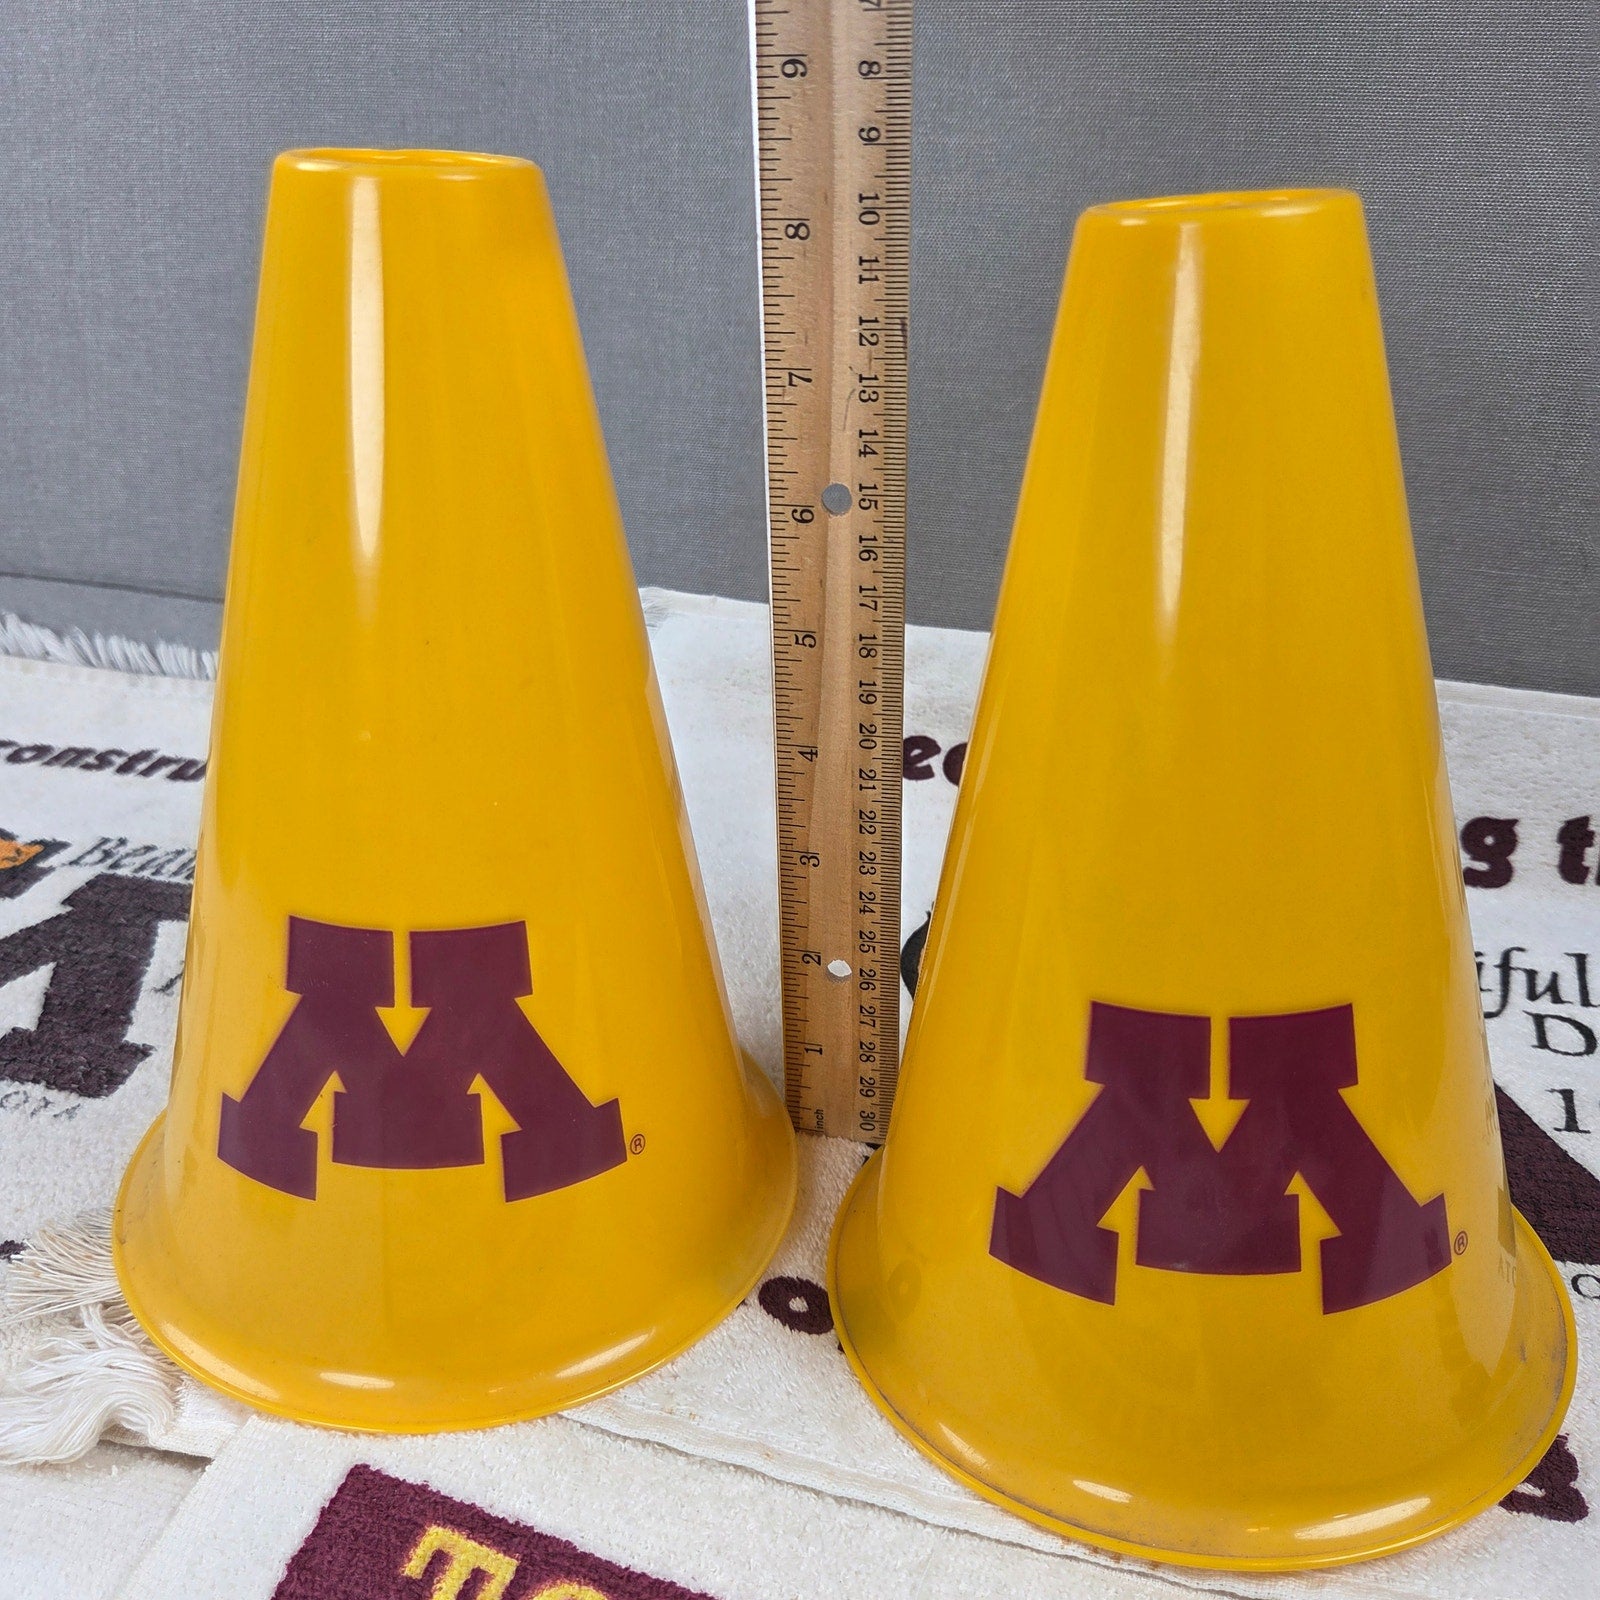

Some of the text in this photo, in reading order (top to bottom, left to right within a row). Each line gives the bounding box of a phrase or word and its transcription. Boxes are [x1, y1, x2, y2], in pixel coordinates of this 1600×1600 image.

[781, 58, 808, 78] 9
[785, 222, 810, 241] 8
[788, 370, 813, 387] 7
[791, 508, 815, 525] 6
[858, 60, 881, 1131] 8 9 10 11 12 13 14 15 16 17 18 19 20 21 22 23 24 25 26 27 28 29 30
[795, 632, 817, 648] 5
[0, 739, 207, 782] onstru
[801, 746, 819, 762] 4
[800, 853, 819, 868] 3
[802, 952, 821, 966] 2
[217, 915, 627, 1203] M
[814, 1109, 824, 1130] inch
[989, 1000, 1453, 1315] M
